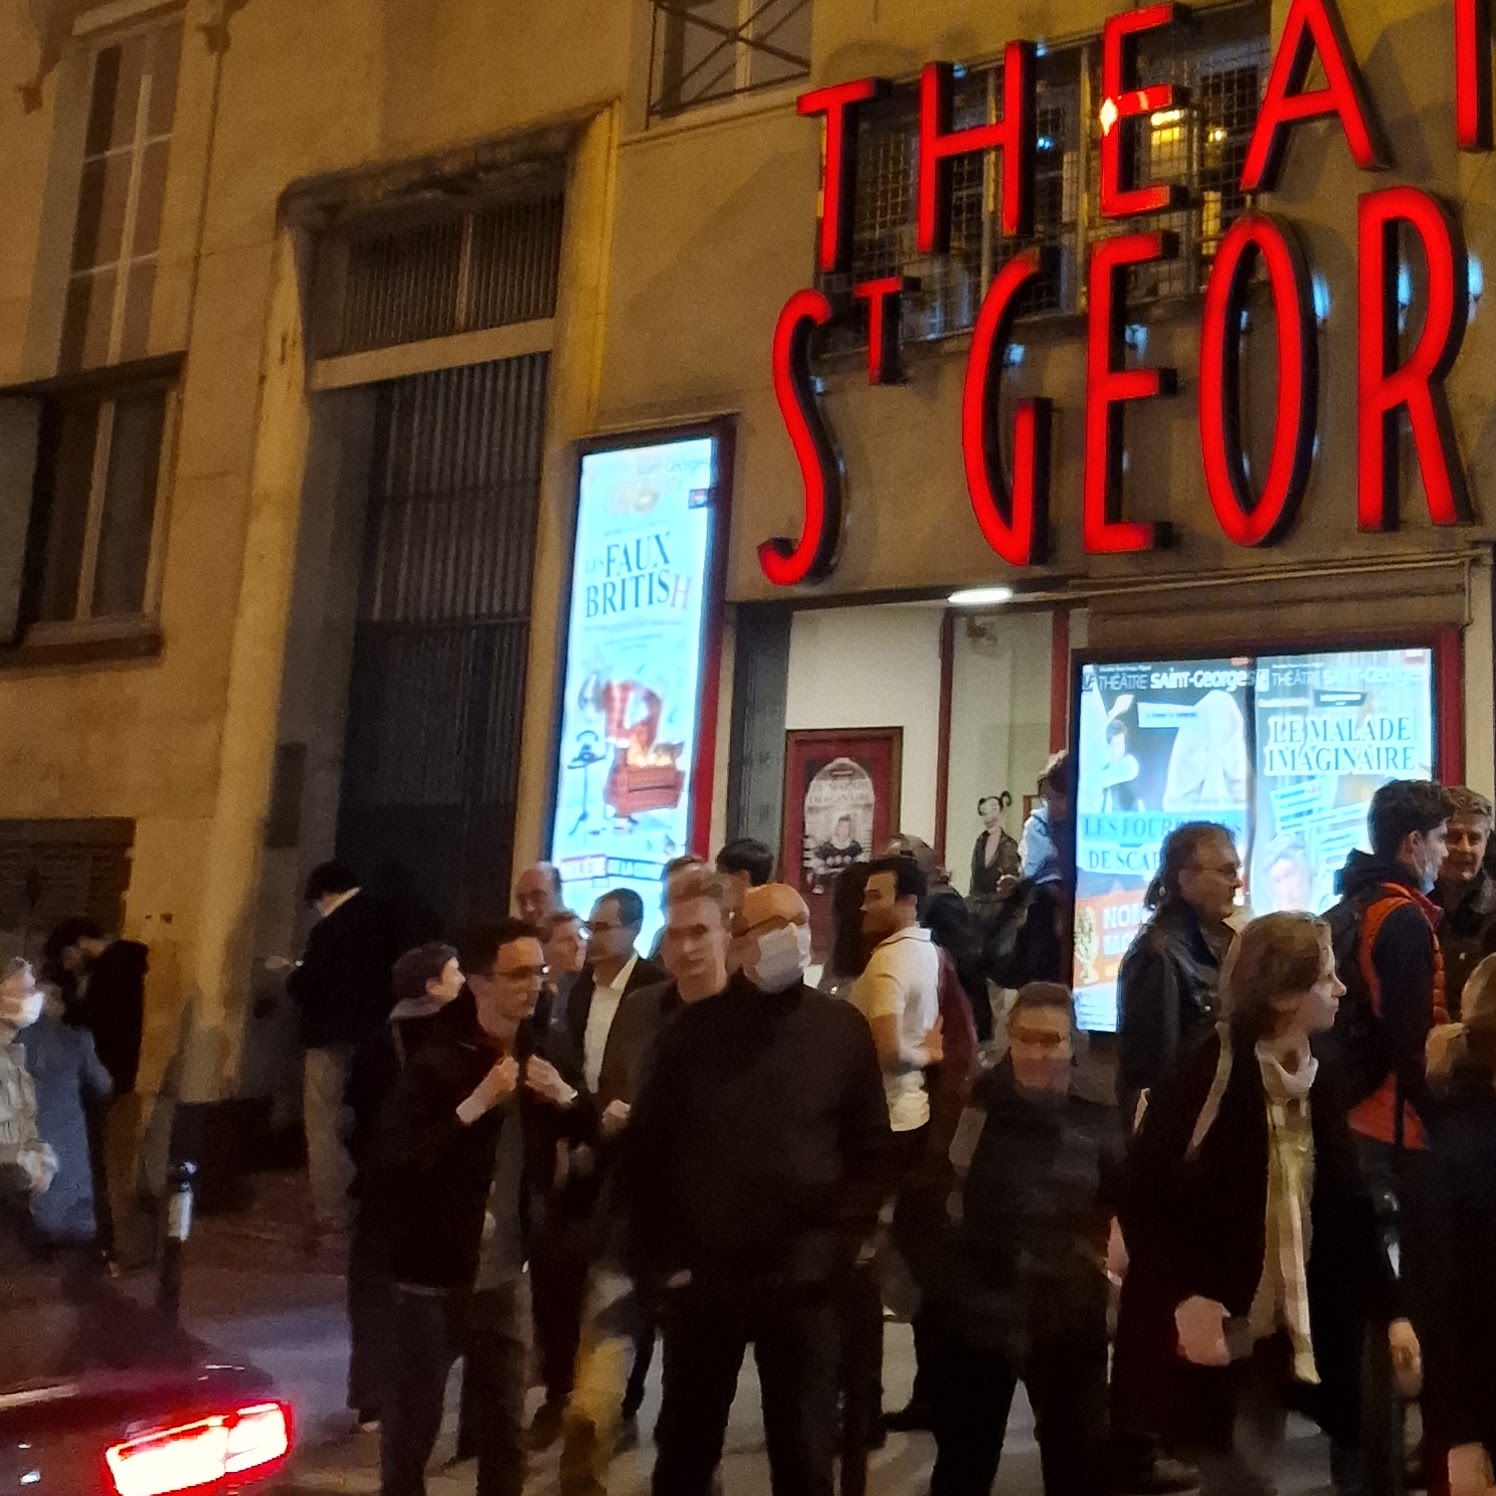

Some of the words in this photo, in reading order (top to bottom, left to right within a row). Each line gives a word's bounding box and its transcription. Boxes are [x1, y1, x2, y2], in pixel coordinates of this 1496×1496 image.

[606, 531, 671, 579] FAUX
[585, 568, 693, 619] BRITISH
[1274, 719, 1302, 743] LE
[1310, 716, 1411, 743] MALADE
[1268, 746, 1416, 772] IMAGINAIRE
[1085, 816, 1119, 837] LES
[1089, 850, 1111, 870] DE
